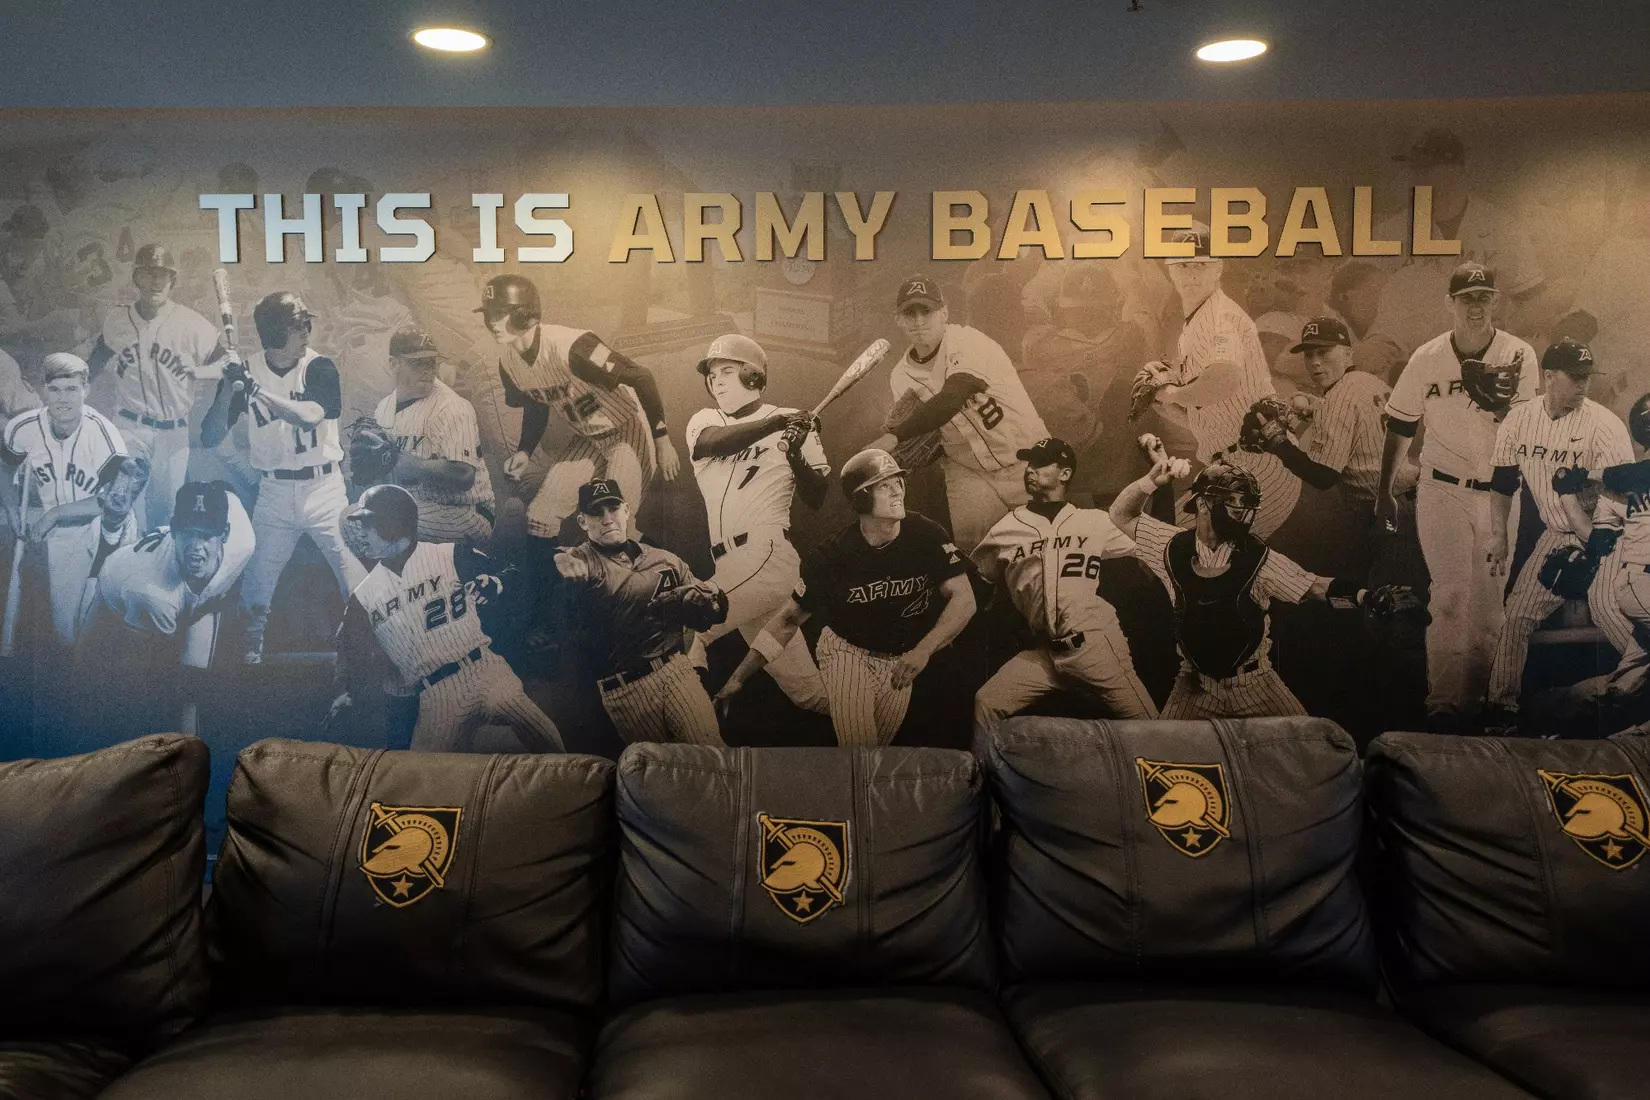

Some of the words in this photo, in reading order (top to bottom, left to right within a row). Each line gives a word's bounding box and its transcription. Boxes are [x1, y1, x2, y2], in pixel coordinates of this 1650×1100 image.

[200, 193, 437, 263] THIS
[472, 193, 574, 263] IS
[608, 191, 898, 263] ARMY
[932, 186, 1463, 260] BASEBALL
[1426, 380, 1464, 399] AR
[1516, 444, 1583, 464] ARMY
[737, 465, 760, 490] 1
[193, 494, 207, 513] A
[1013, 536, 1088, 563] ARMY
[1060, 553, 1100, 580] 26
[370, 576, 441, 627] ARMY
[847, 573, 929, 603] ARMY
